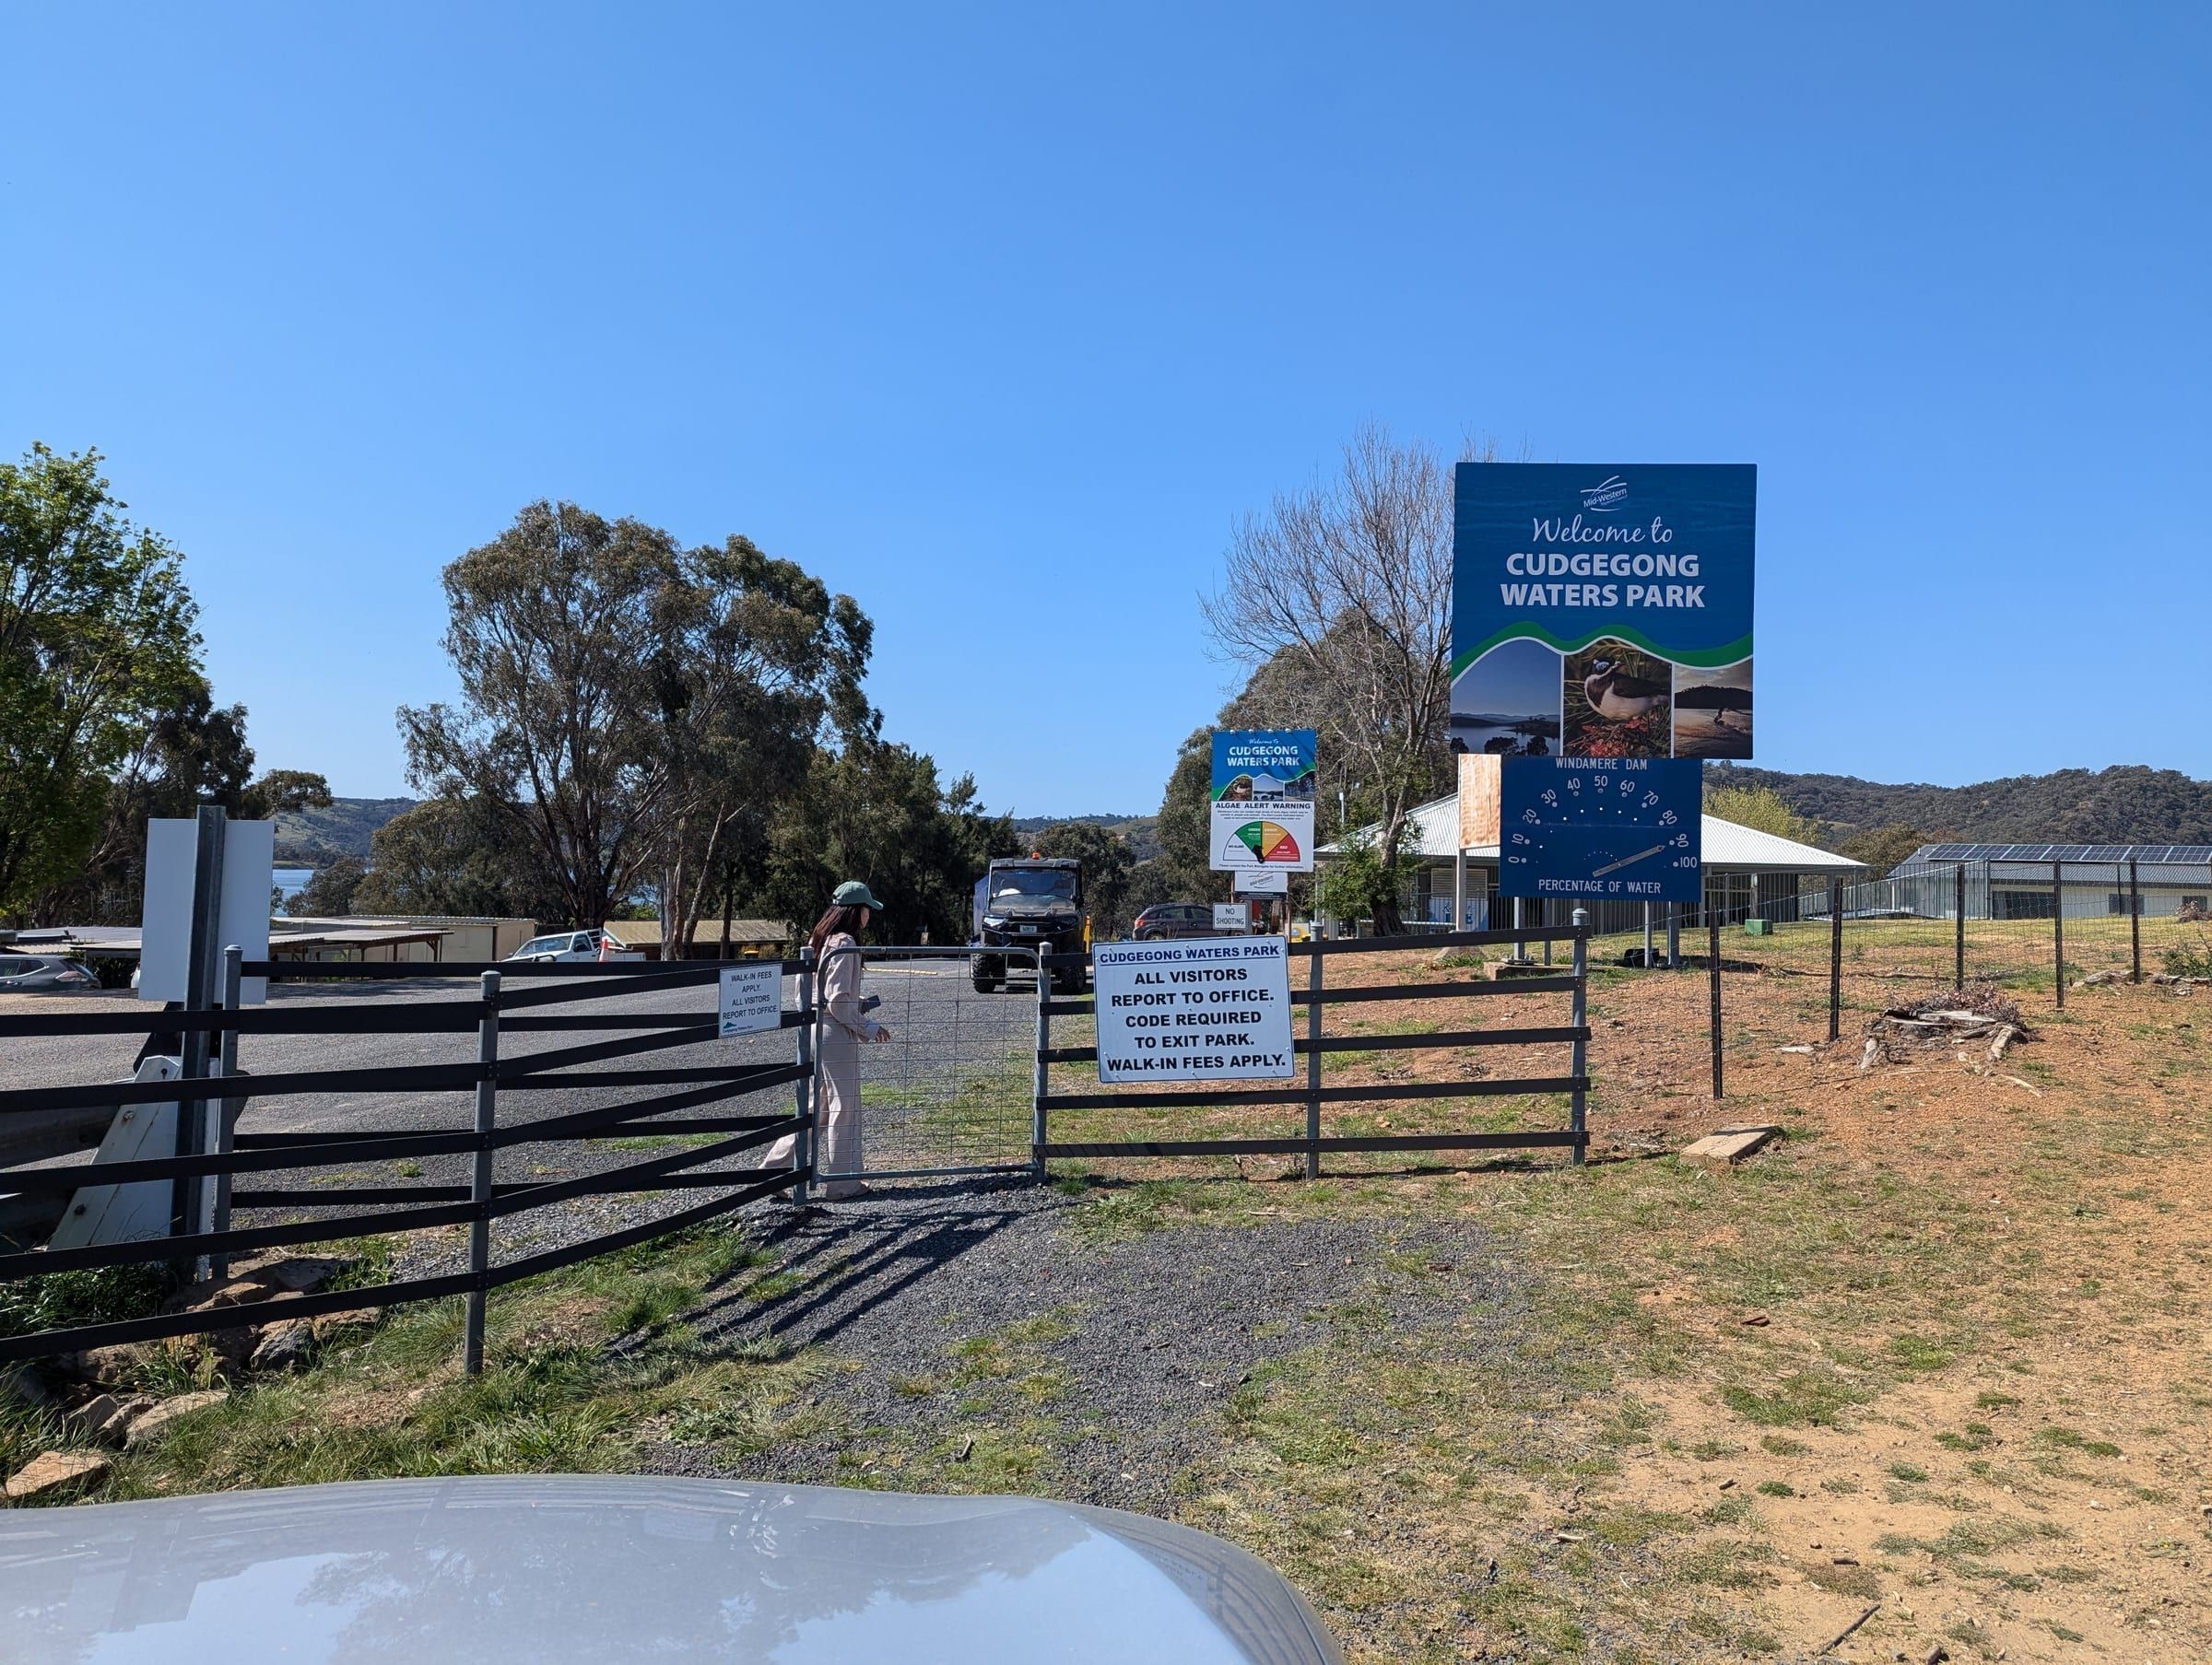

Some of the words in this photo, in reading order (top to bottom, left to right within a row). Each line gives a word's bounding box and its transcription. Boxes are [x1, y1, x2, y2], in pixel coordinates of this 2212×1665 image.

[1583, 487, 1627, 508] Mid-Western
[1533, 514, 1646, 544] Welcome
[1651, 516, 1673, 544] to
[1506, 553, 1700, 578] CUDGEGONG
[1500, 583, 1618, 607] WATERS
[1626, 585, 1705, 608] PARK
[1230, 746, 1298, 756] CUDGEGONG
[1228, 757, 1268, 767] WATERS
[1271, 757, 1300, 766] PARK
[1555, 757, 1618, 770] WINDAMERE
[1626, 758, 1647, 770] DAM
[1567, 777, 1581, 791] 40
[1594, 775, 1608, 787] 50
[1619, 780, 1635, 792] 60
[1541, 789, 1557, 803] 30
[1643, 791, 1659, 805] 70
[1523, 808, 1537, 824] 20
[1662, 810, 1677, 826] 80
[1512, 833, 1524, 845] 10
[1677, 833, 1688, 848] 90
[1679, 856, 1698, 868] 100
[1538, 879, 1604, 893] PERCENTAGE
[1608, 881, 1621, 893] OF
[1627, 881, 1661, 894] WATER
[1216, 917, 1244, 925] SHOOTING
[1100, 950, 1182, 963] CUDGEGONG
[1185, 947, 1240, 960] WATERS
[1243, 945, 1279, 956] PARK
[731, 973, 756, 982] WALK-IN
[1135, 972, 1165, 985] ALL
[1170, 968, 1248, 983] VISITORS
[742, 984, 760, 992] APPLY.
[732, 998, 743, 1006] ALL
[744, 995, 771, 1004] VISITORS
[1112, 992, 1176, 1007] REPORT
[1182, 991, 1204, 1004] TO
[1209, 989, 1275, 1003] OFFICE.
[723, 1009, 747, 1020] REPORT
[747, 1008, 756, 1016] TO
[1125, 1014, 1171, 1027] CODE
[1176, 1011, 1262, 1026] REQUIRED
[1135, 1037, 1157, 1049] TO
[1162, 1035, 1199, 1048] EXIT
[1205, 1033, 1254, 1047] PARK.
[1107, 1057, 1177, 1072] WALK-IN
[1182, 1056, 1224, 1069] FEES
[1230, 1054, 1286, 1068] APPLY.
